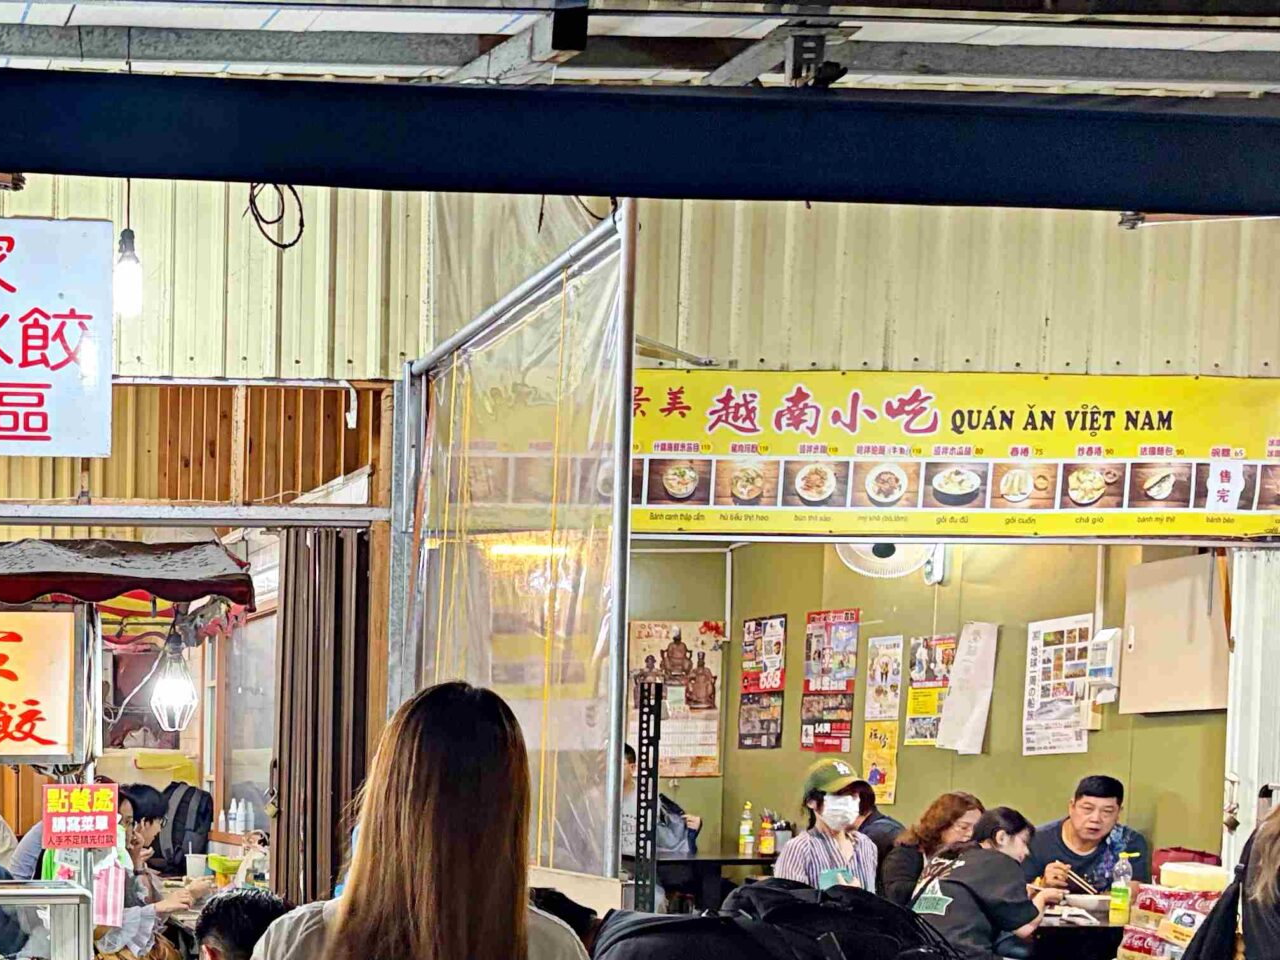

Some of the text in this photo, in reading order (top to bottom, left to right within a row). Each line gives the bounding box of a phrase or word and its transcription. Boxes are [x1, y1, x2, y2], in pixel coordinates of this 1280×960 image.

[708, 386, 939, 435] 越南小吃
[951, 405, 1015, 435] QUÁN
[1124, 410, 1173, 431] NAM
[1216, 469, 1232, 503] 售完
[47, 788, 114, 813] 點餐處
